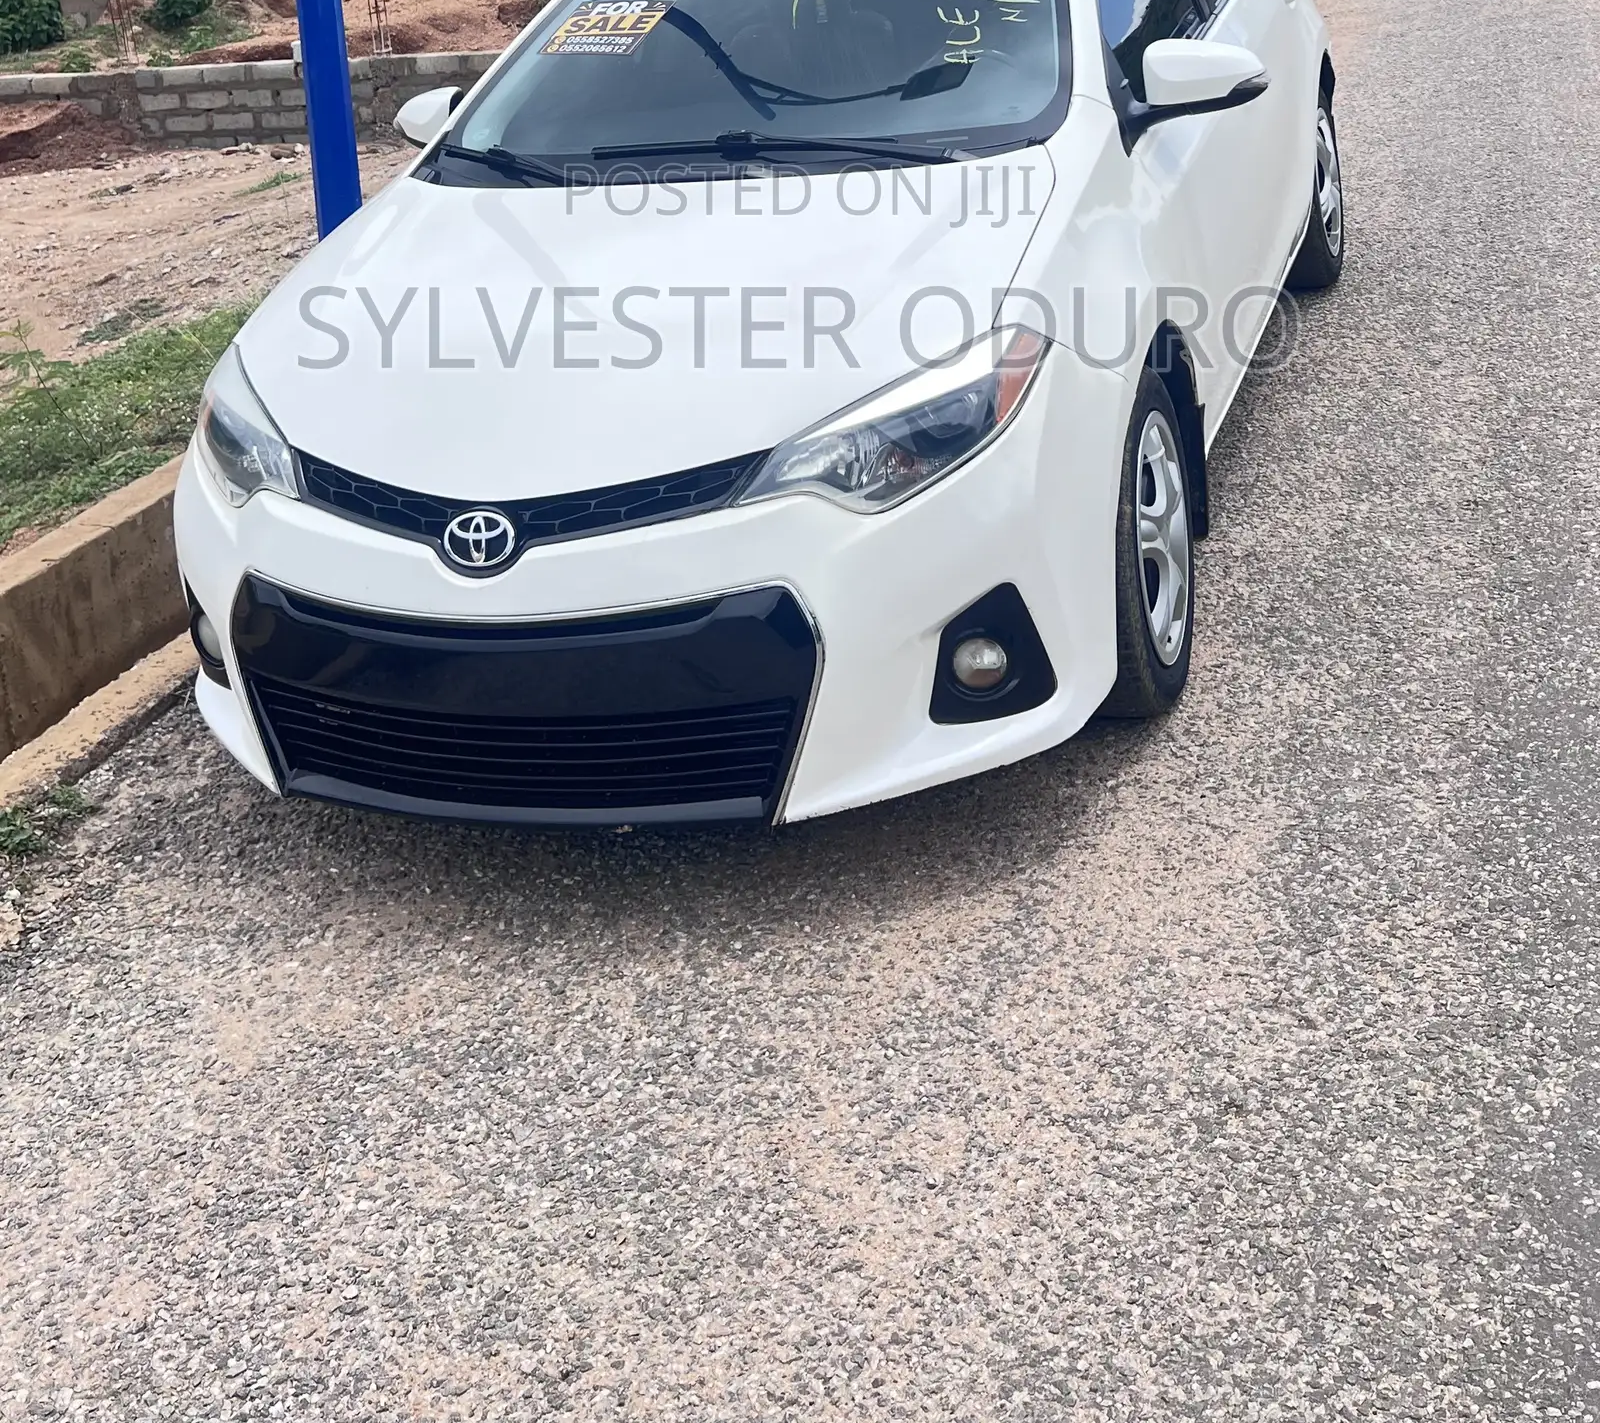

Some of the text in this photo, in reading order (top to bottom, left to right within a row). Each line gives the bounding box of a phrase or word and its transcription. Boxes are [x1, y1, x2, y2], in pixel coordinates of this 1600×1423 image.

[589, 0, 649, 16] FOR
[564, 14, 656, 34] SALE
[559, 44, 626, 53] 0552065612
